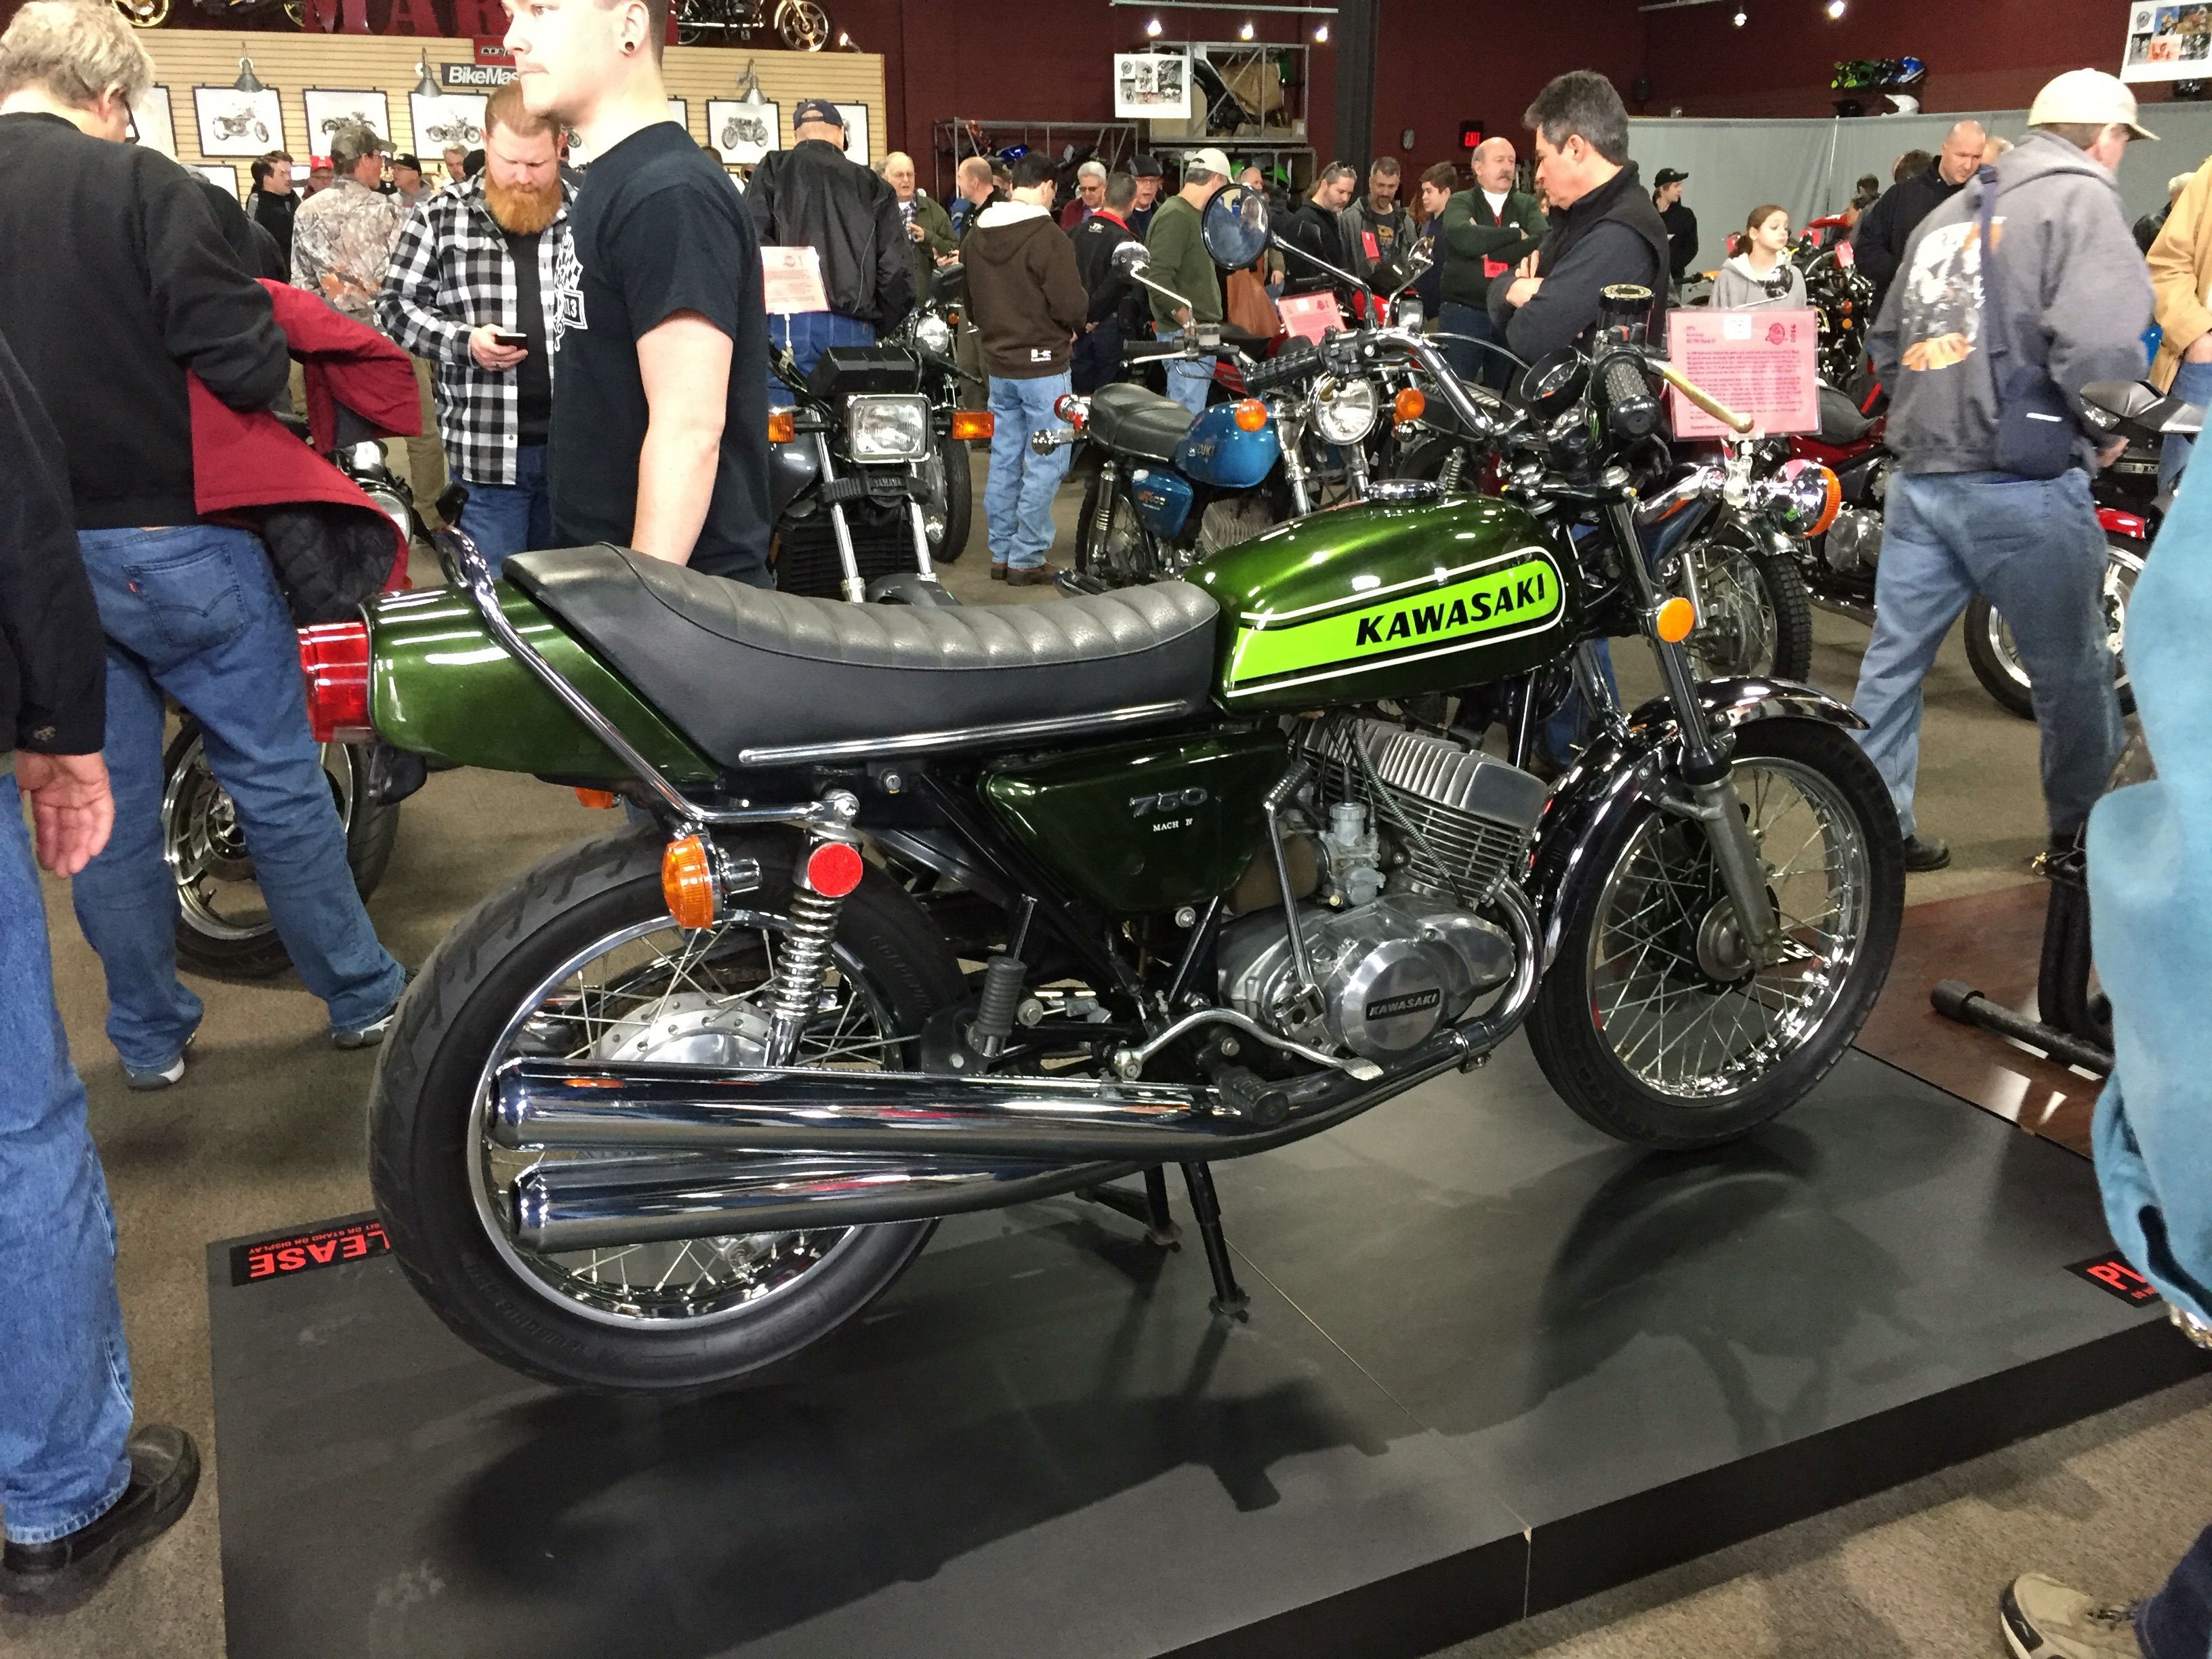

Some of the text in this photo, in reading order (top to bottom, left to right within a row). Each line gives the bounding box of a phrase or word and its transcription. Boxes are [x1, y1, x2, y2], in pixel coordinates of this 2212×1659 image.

[449, 66, 520, 85] BikeMas
[1355, 573, 1545, 647] KAWASAKI
[1129, 787, 1208, 817] 750
[1153, 817, 1193, 832] MACH IV
[1369, 993, 1437, 1017] KAWASAKI
[249, 1241, 291, 1254] DISPLAY
[249, 1230, 390, 1278] LEASE
